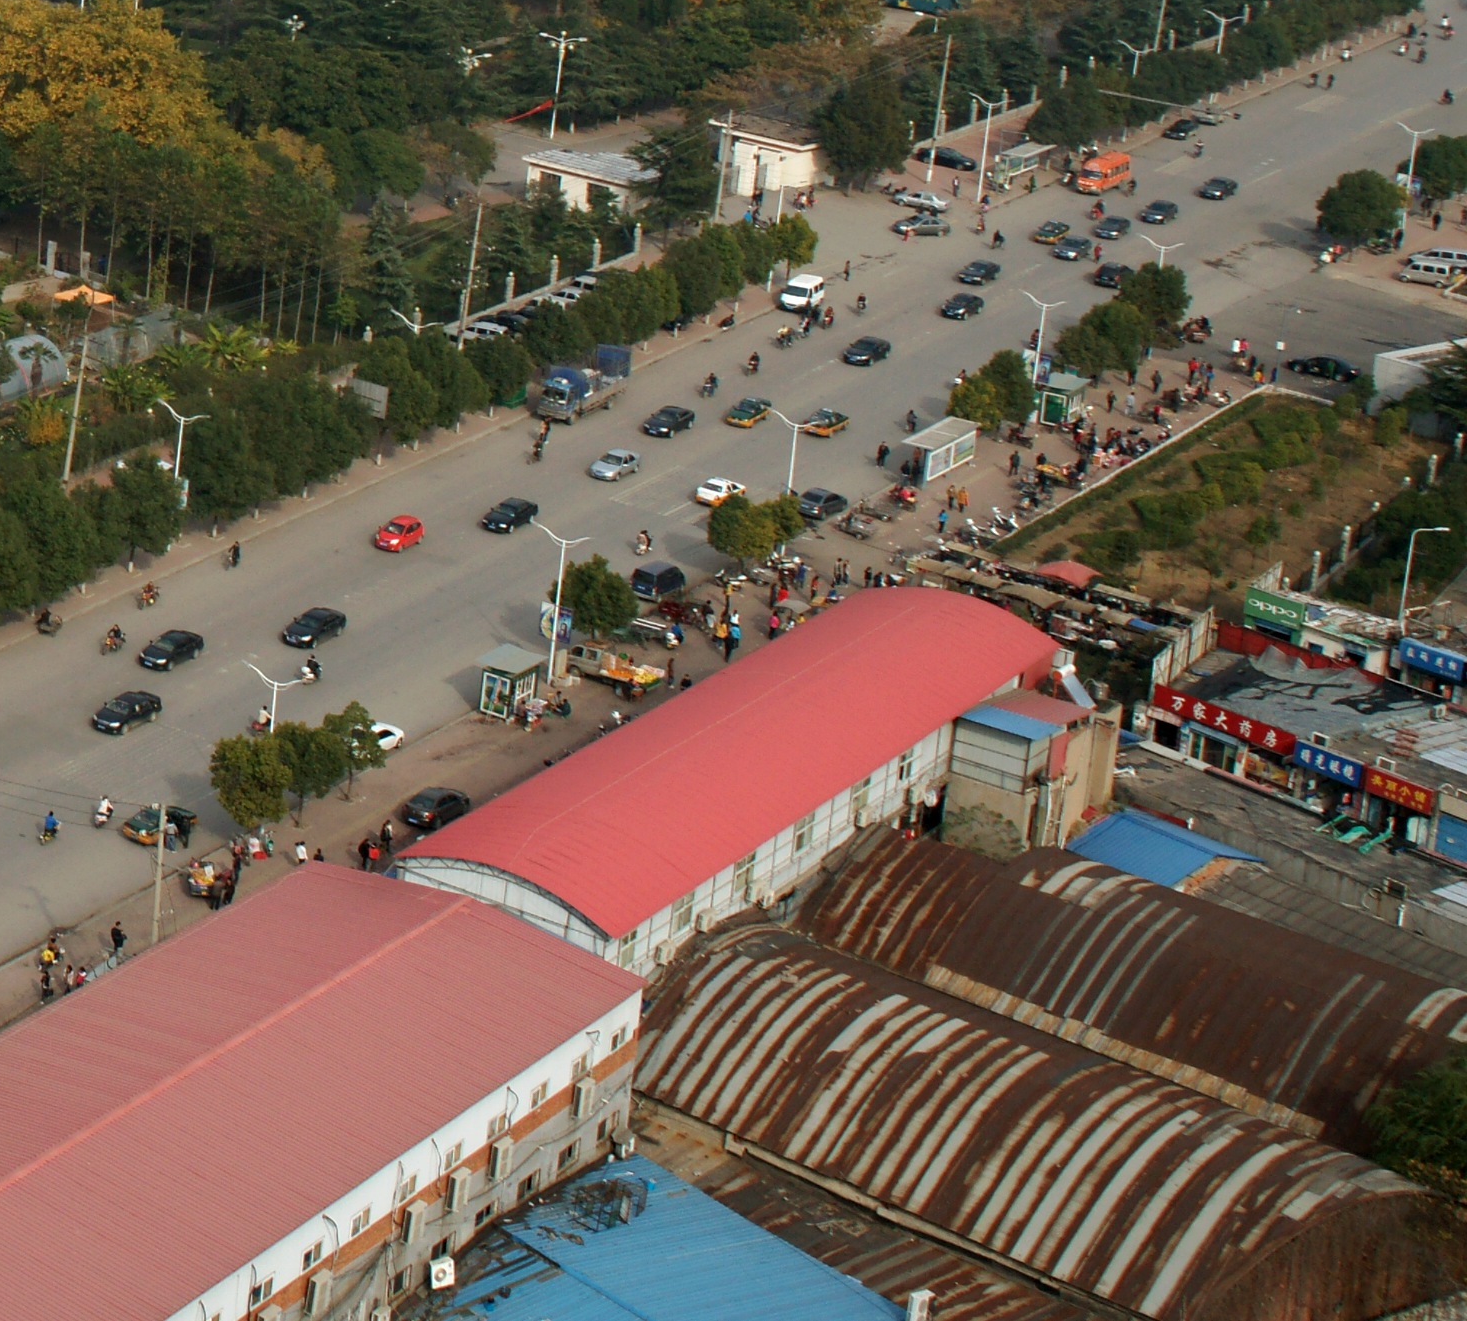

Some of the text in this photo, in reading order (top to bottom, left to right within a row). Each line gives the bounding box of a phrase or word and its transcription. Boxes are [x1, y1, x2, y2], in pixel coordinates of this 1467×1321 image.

[1171, 695, 1278, 749] 万家大药房
